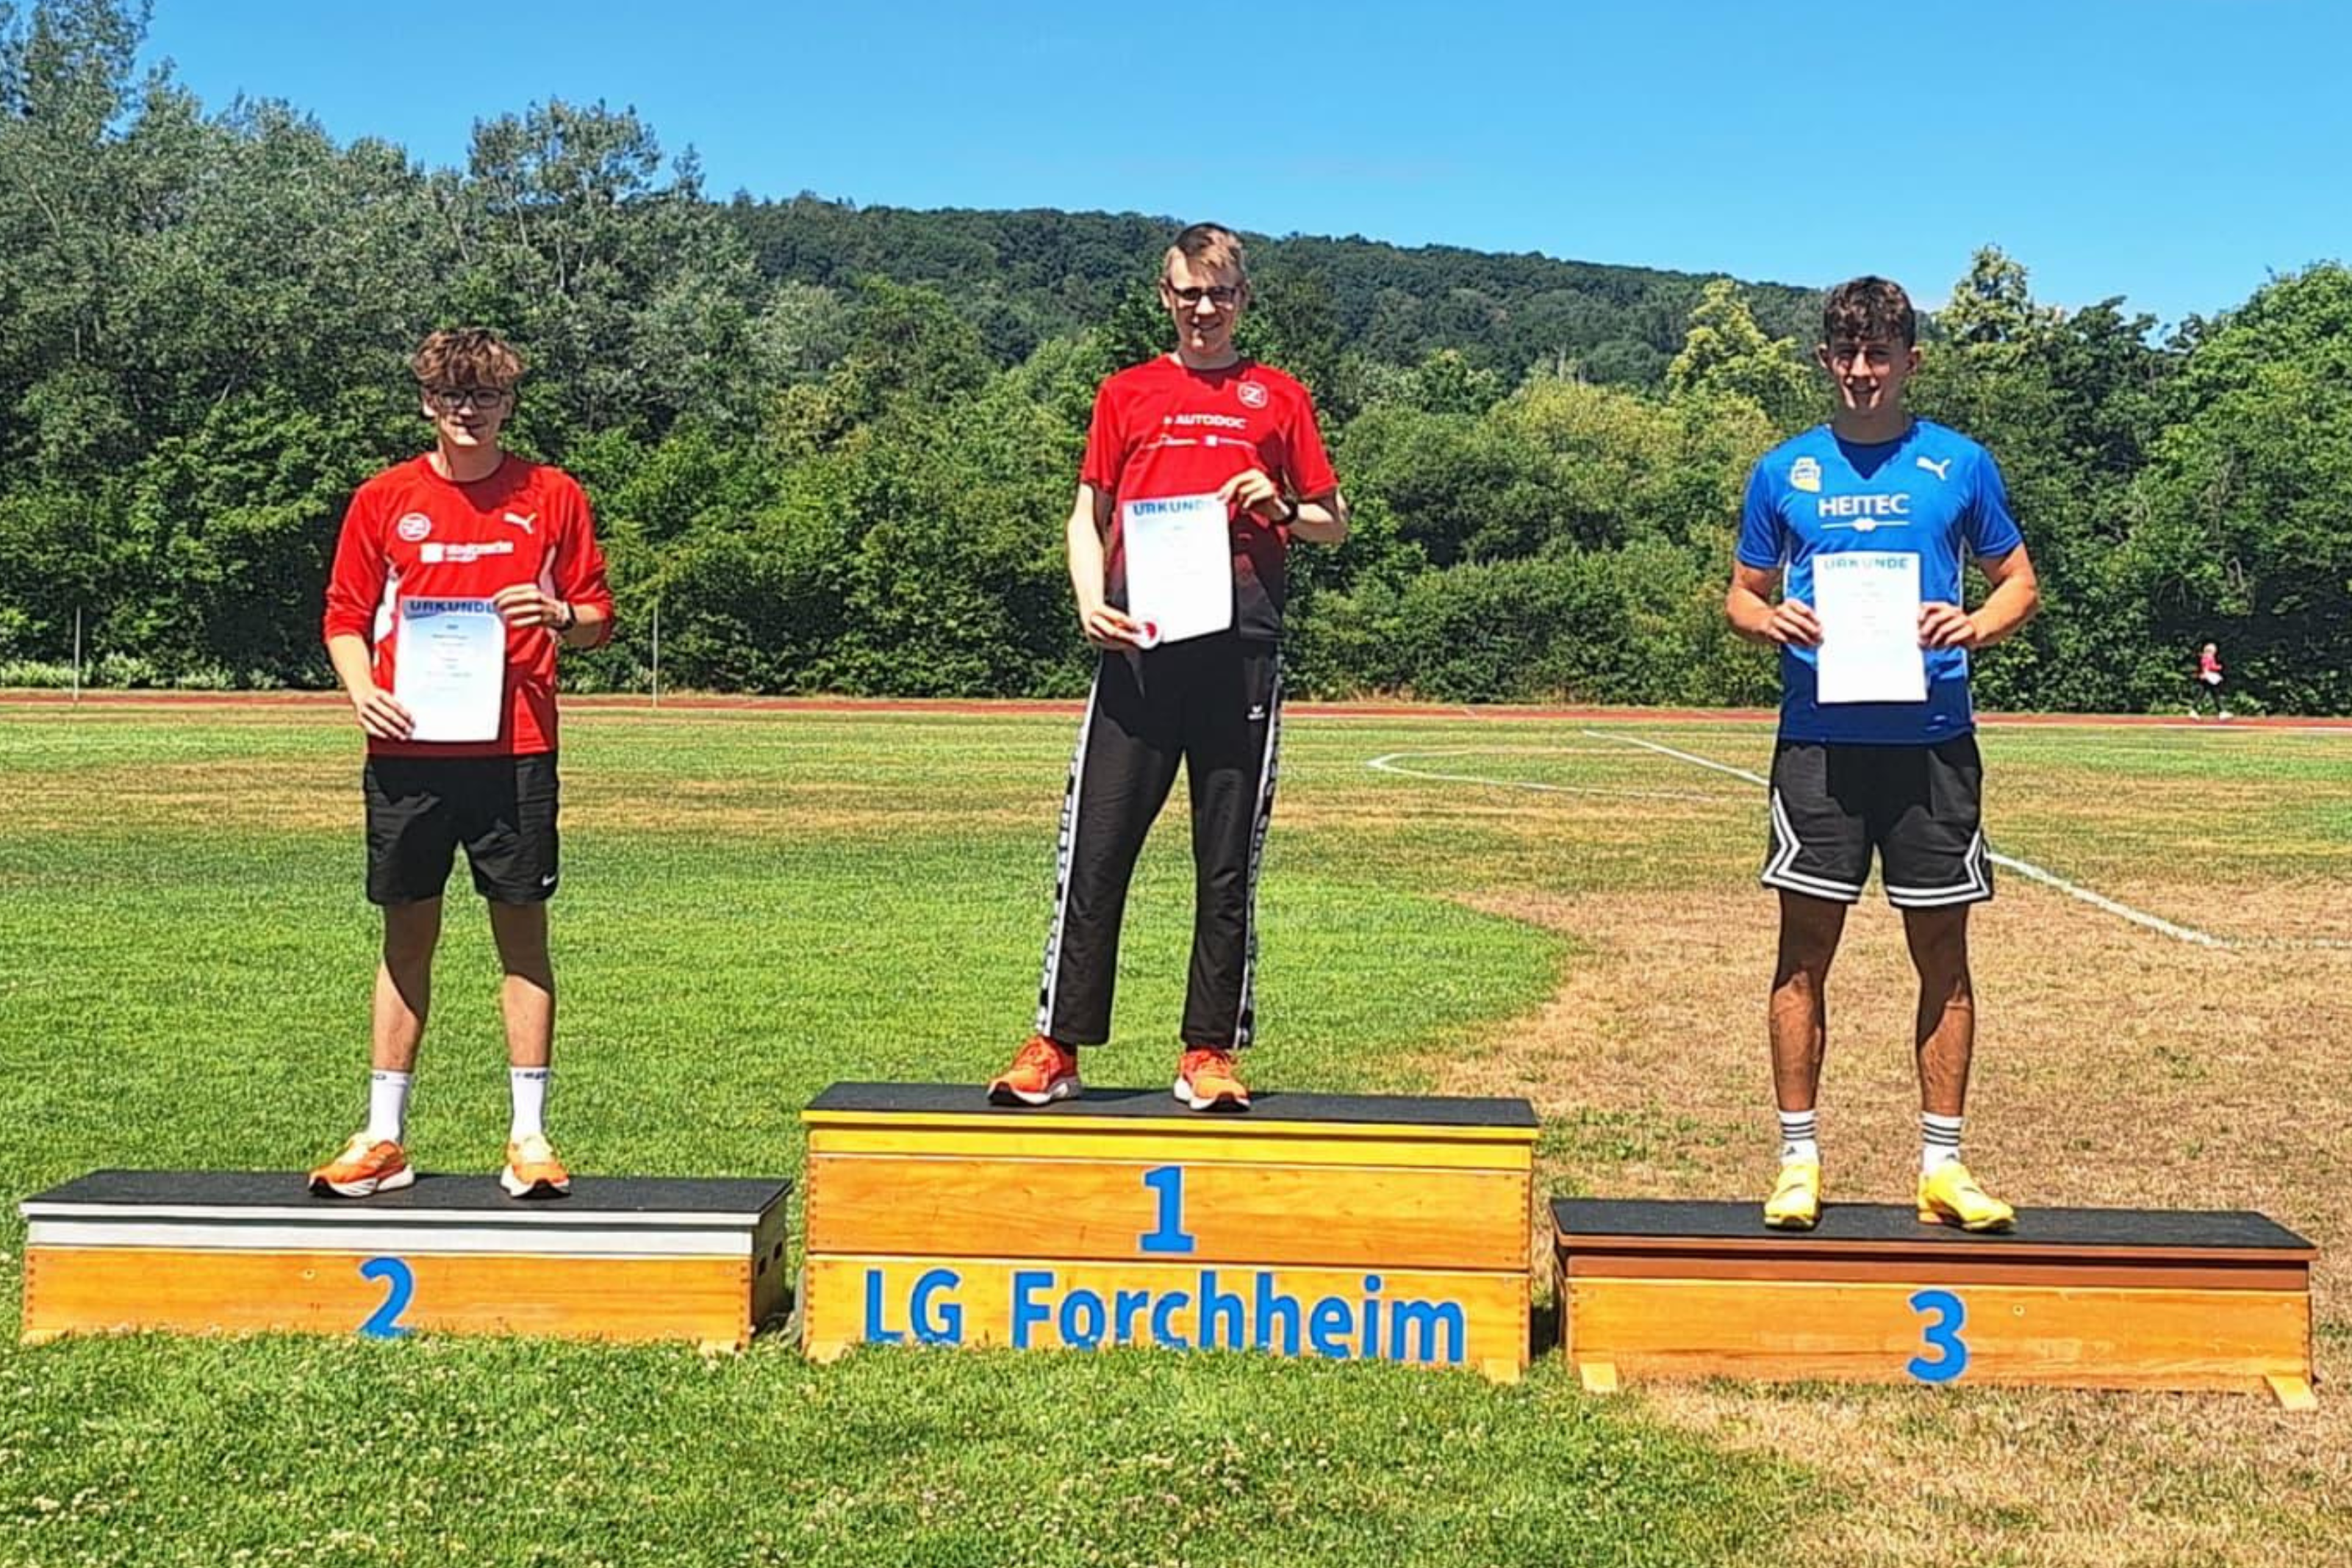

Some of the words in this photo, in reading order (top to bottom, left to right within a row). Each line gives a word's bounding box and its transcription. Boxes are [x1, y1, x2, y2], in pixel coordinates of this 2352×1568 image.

[1175, 414, 1247, 429] AUTODOC
[1133, 498, 1211, 517] URKUND
[1818, 492, 1910, 518] HEITEC
[1823, 557, 1910, 570] URKUNDE
[1141, 1165, 1194, 1254] 1
[359, 1256, 415, 1339] 2
[866, 1269, 963, 1344] LG
[1012, 1270, 1464, 1363] Forchheim
[1907, 1289, 1968, 1383] 3
